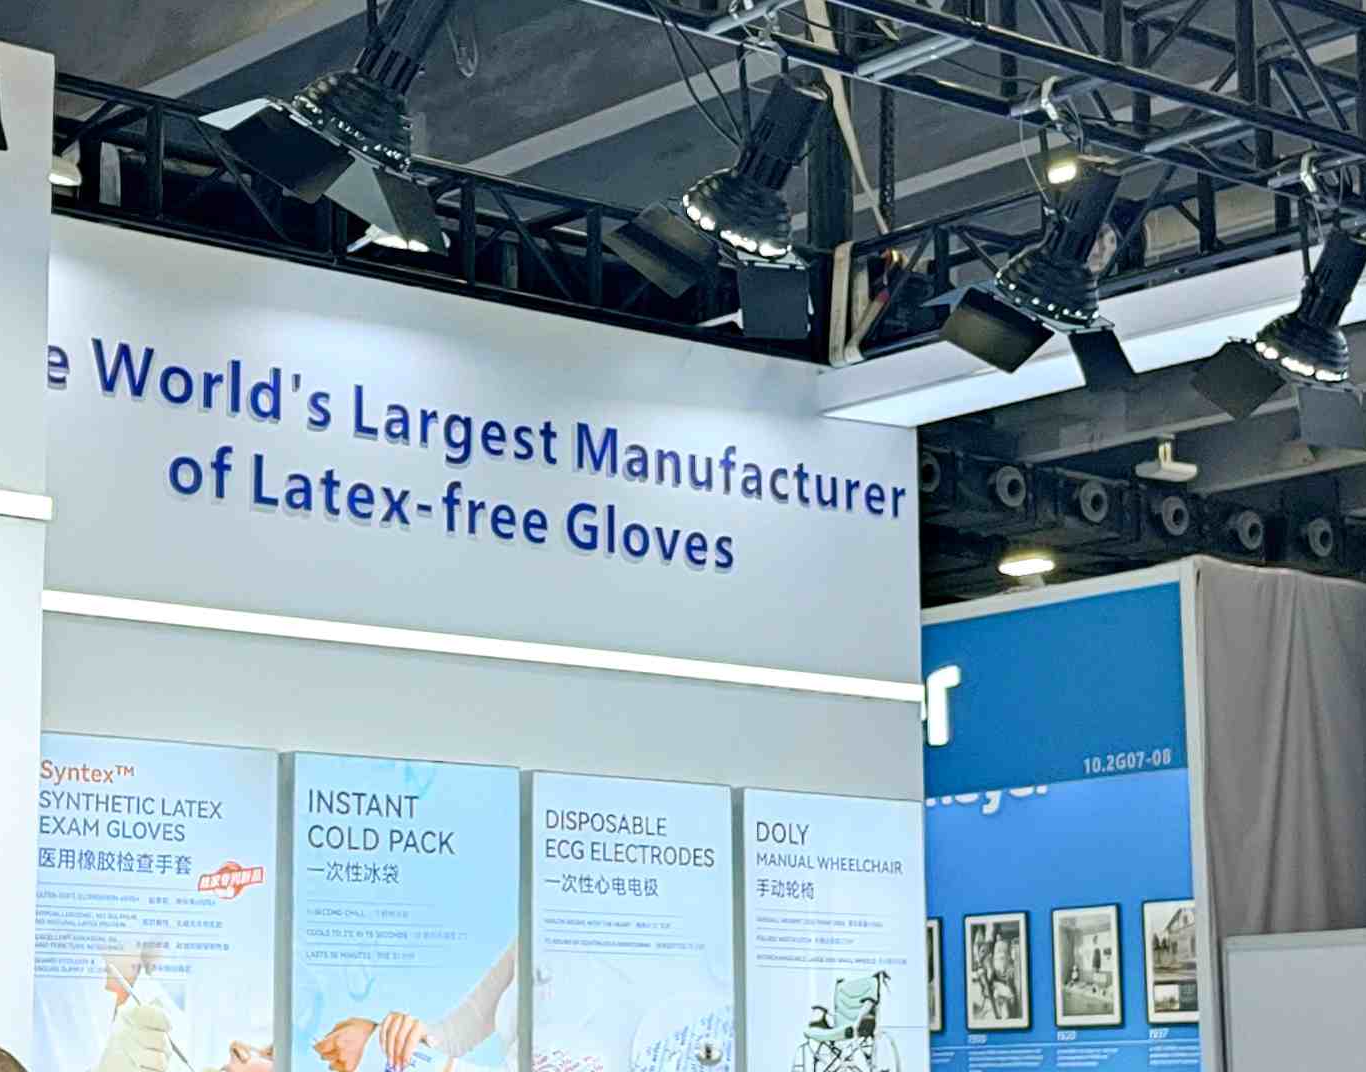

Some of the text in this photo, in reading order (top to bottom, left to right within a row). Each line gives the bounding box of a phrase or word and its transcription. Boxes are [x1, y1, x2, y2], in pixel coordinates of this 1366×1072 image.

[46, 337, 907, 522] e World's Largest Manufacturer
[168, 445, 734, 570] of Latex-free Gloves
[1083, 748, 1172, 774] 10.2G07-08
[38, 790, 223, 820] SYNTHETIC LATEX
[308, 788, 420, 819] INSTANT
[39, 815, 186, 842] EXAM GLOVES
[546, 809, 668, 837] DISPOSABLE
[756, 821, 810, 846] DOLY
[307, 824, 457, 855] COLD PACK
[546, 838, 716, 868] ECG ELECTRODES
[38, 847, 193, 876] 医用橡胶检查手套
[306, 860, 400, 885] 一次性冰袋
[756, 852, 903, 875] MANUAL WHEELCHAIR
[544, 872, 660, 897] 一次性心电电极
